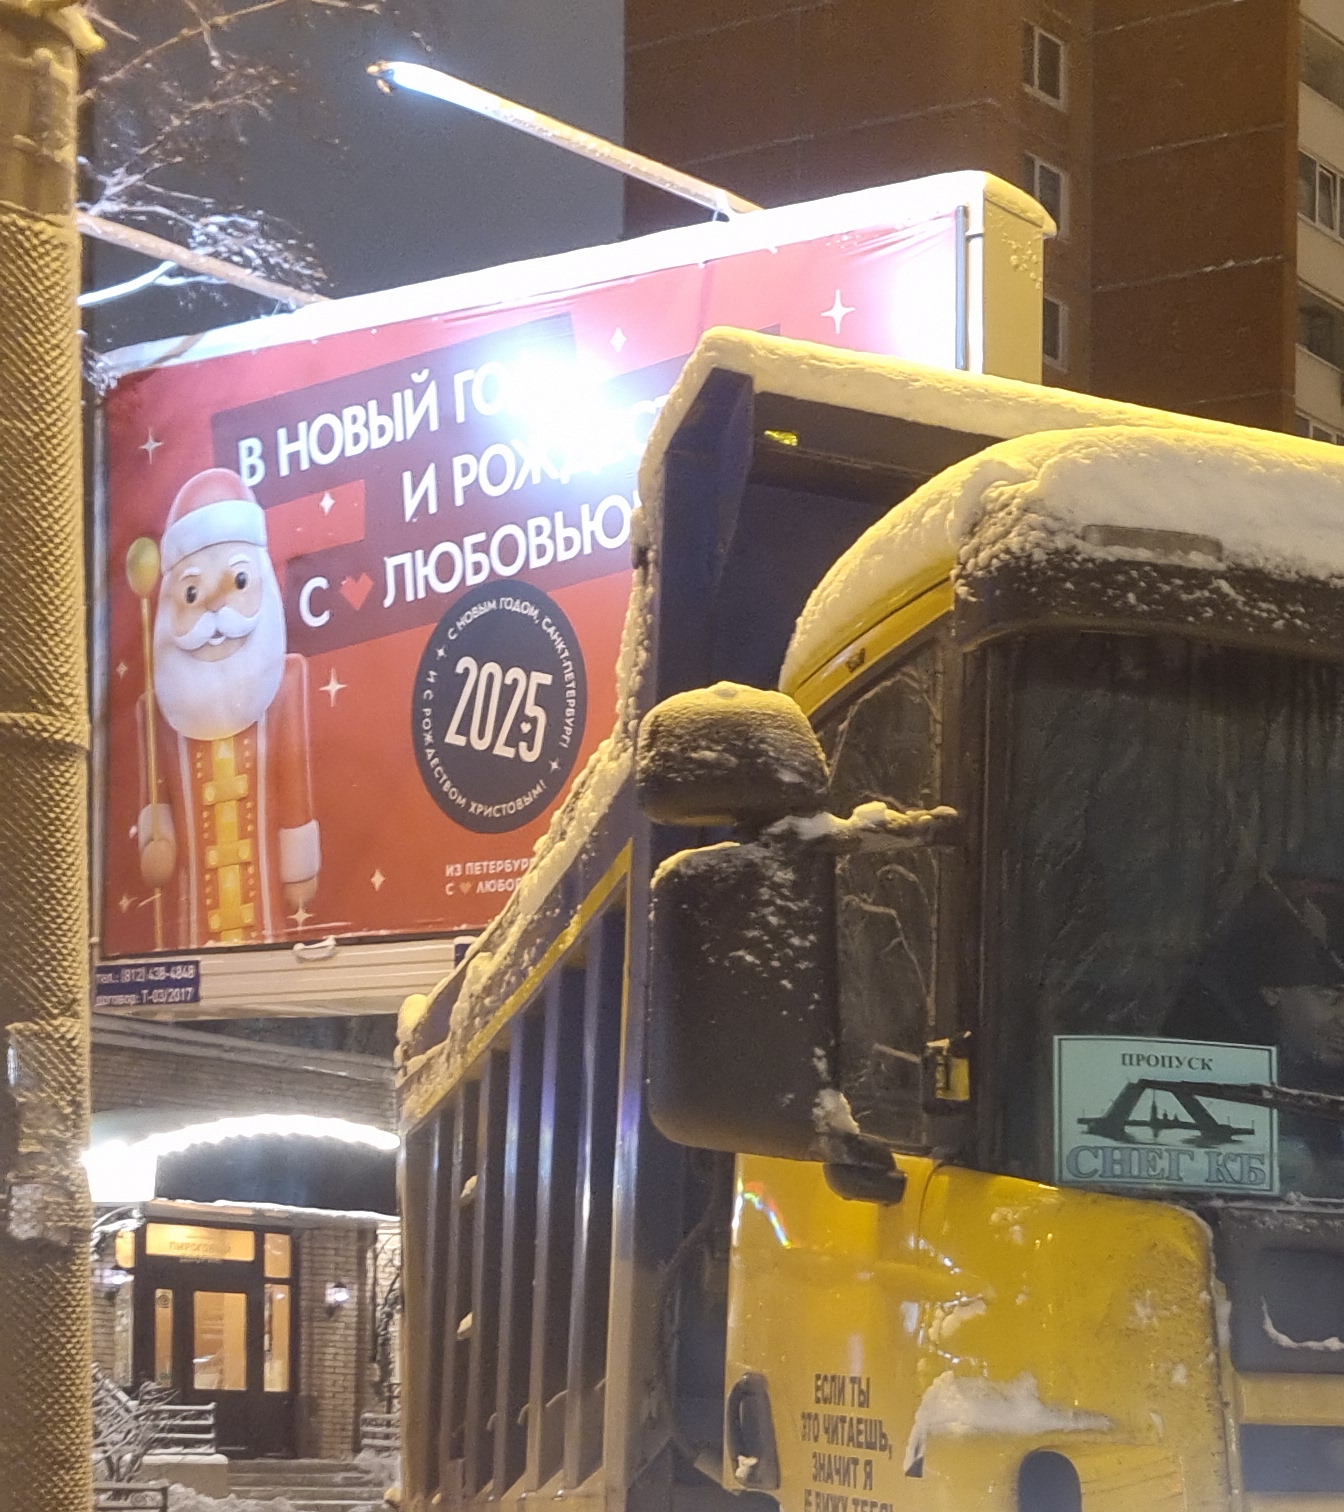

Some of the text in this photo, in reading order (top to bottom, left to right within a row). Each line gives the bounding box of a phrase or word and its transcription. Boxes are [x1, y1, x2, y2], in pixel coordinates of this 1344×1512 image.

[238, 436, 267, 487] В
[277, 372, 440, 478] НОВЫЙ
[403, 469, 437, 524] И
[298, 489, 641, 631] С ЛЮБОВЬЮ
[447, 597, 577, 749] С НОВЫМ ГОДОМ, САНКТ-ПЕТЕРБУРГ!
[444, 655, 553, 763] 2025
[421, 670, 547, 818] И С РОЖДЕСТВОМ ХРИСТОВЫМ!
[445, 863, 463, 878] ИЗ
[445, 882, 455, 896] С
[1121, 1052, 1214, 1071] ПРОПУСК
[1065, 1145, 1266, 1186] СНЕГ КБ
[815, 1373, 871, 1409] ЕСЛИ ТЫ
[801, 1411, 893, 1460] ЭТО ЧИТАЕШЬ,
[812, 1451, 874, 1491] ЗНАЧИТ Я
